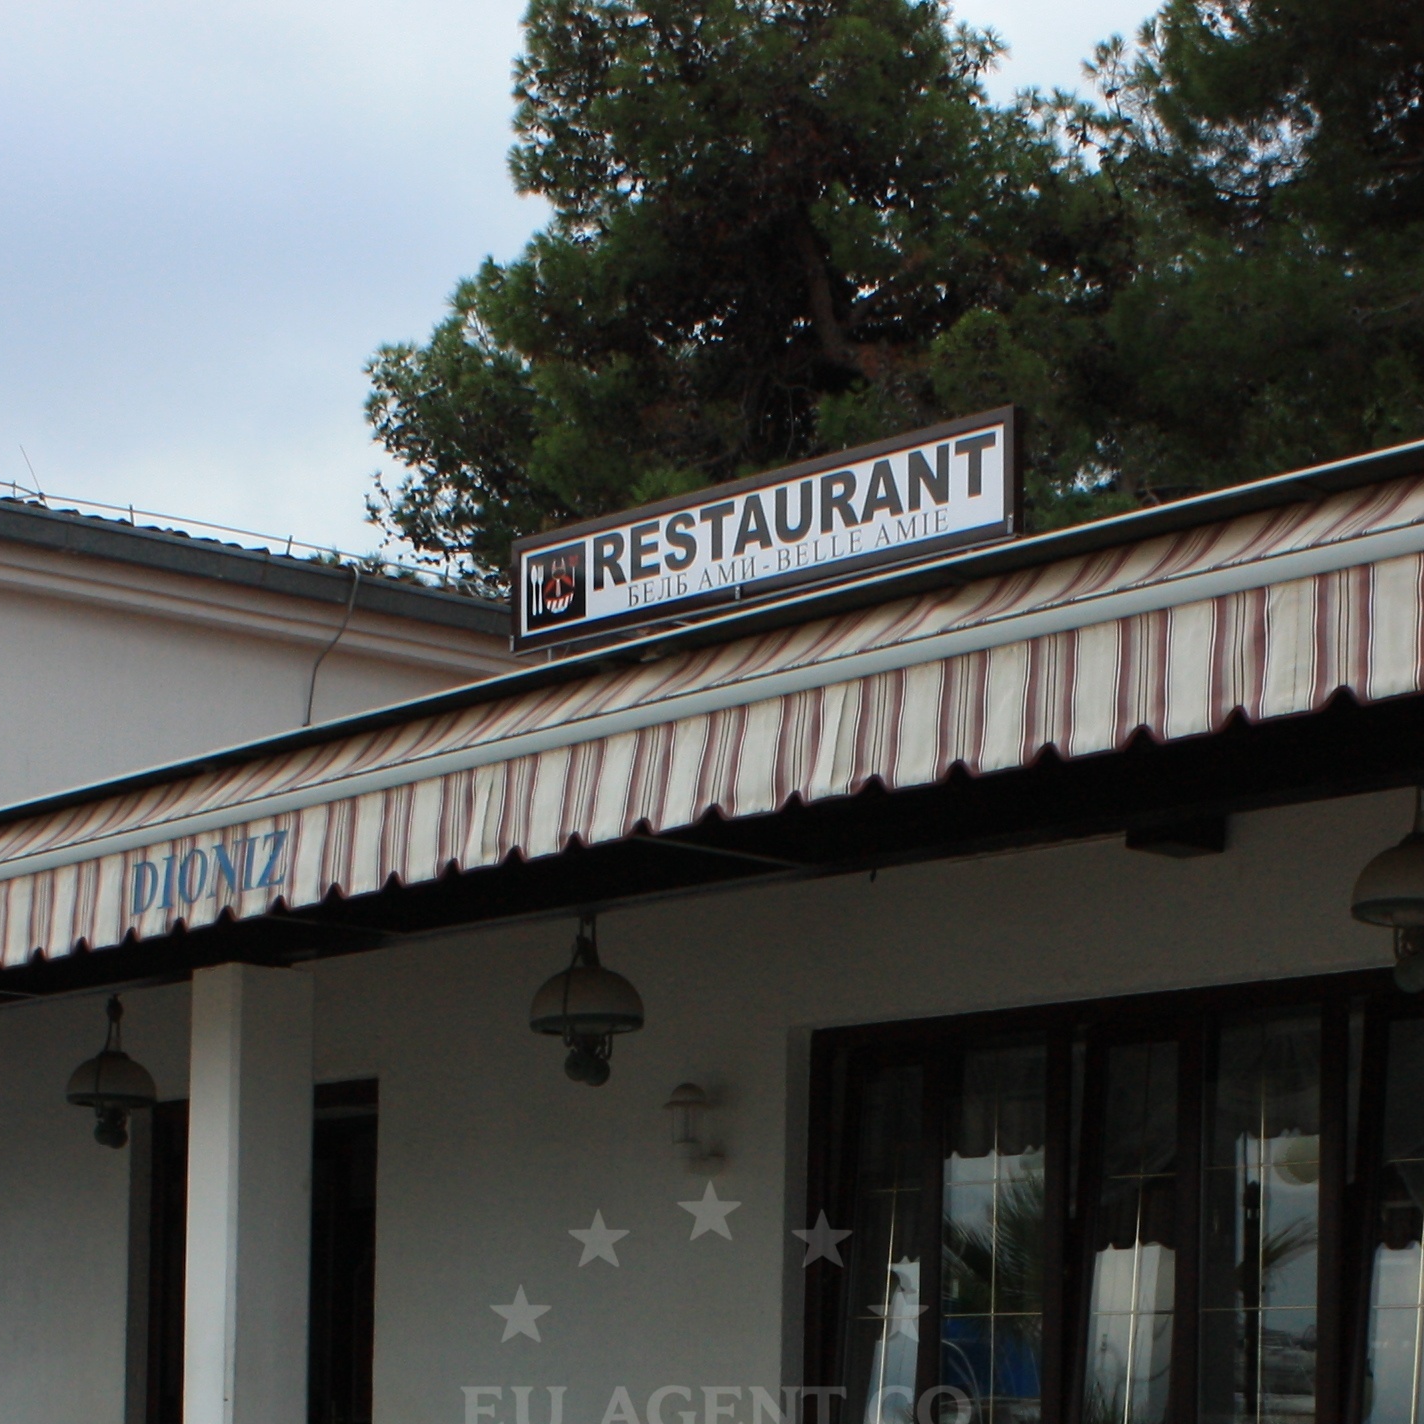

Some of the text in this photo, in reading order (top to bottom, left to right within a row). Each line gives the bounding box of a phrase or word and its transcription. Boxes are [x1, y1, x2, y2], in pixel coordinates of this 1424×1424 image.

[592, 432, 997, 590] RESTAURANT
[699, 556, 756, 590] АМИ
[777, 529, 863, 571] BELLE
[875, 508, 948, 547] AMIE
[132, 830, 288, 914] DIONIZ
